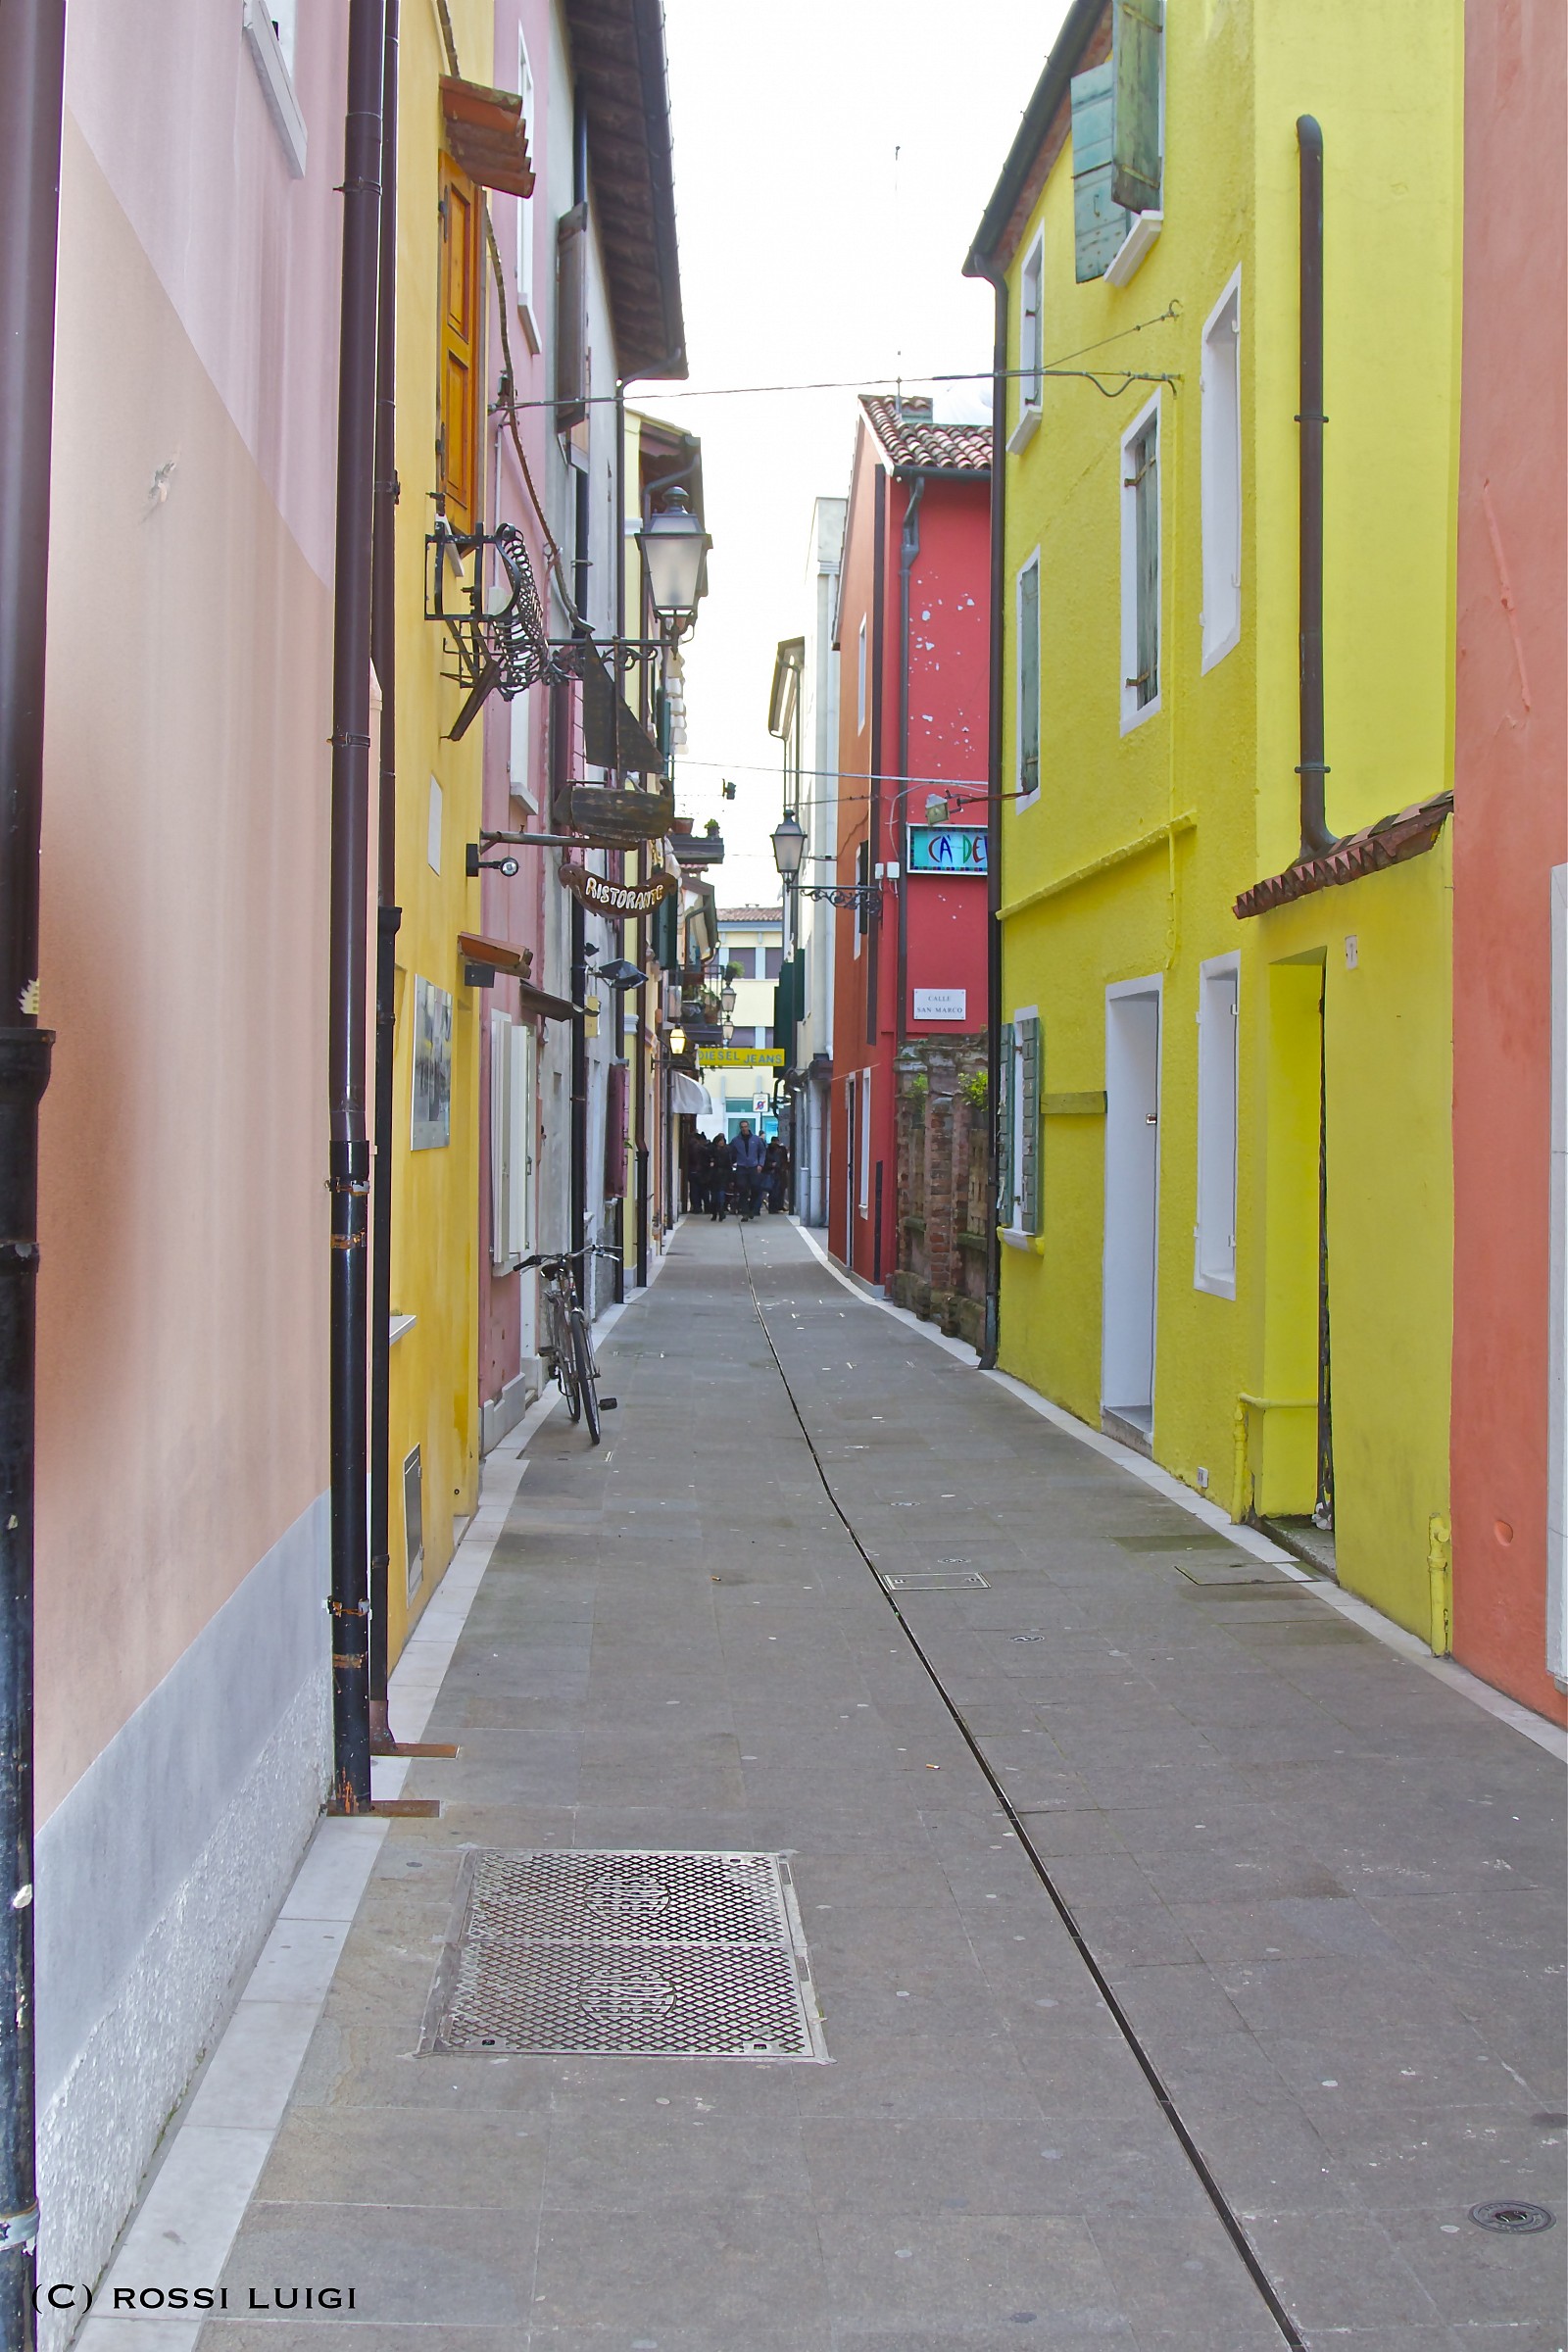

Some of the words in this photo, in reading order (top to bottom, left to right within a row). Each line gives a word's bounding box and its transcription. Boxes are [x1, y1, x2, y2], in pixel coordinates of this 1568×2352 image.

[585, 877, 664, 909] RISTORANTE
[698, 1051, 740, 1061] DIESEL
[744, 1054, 782, 1064] JEANS
